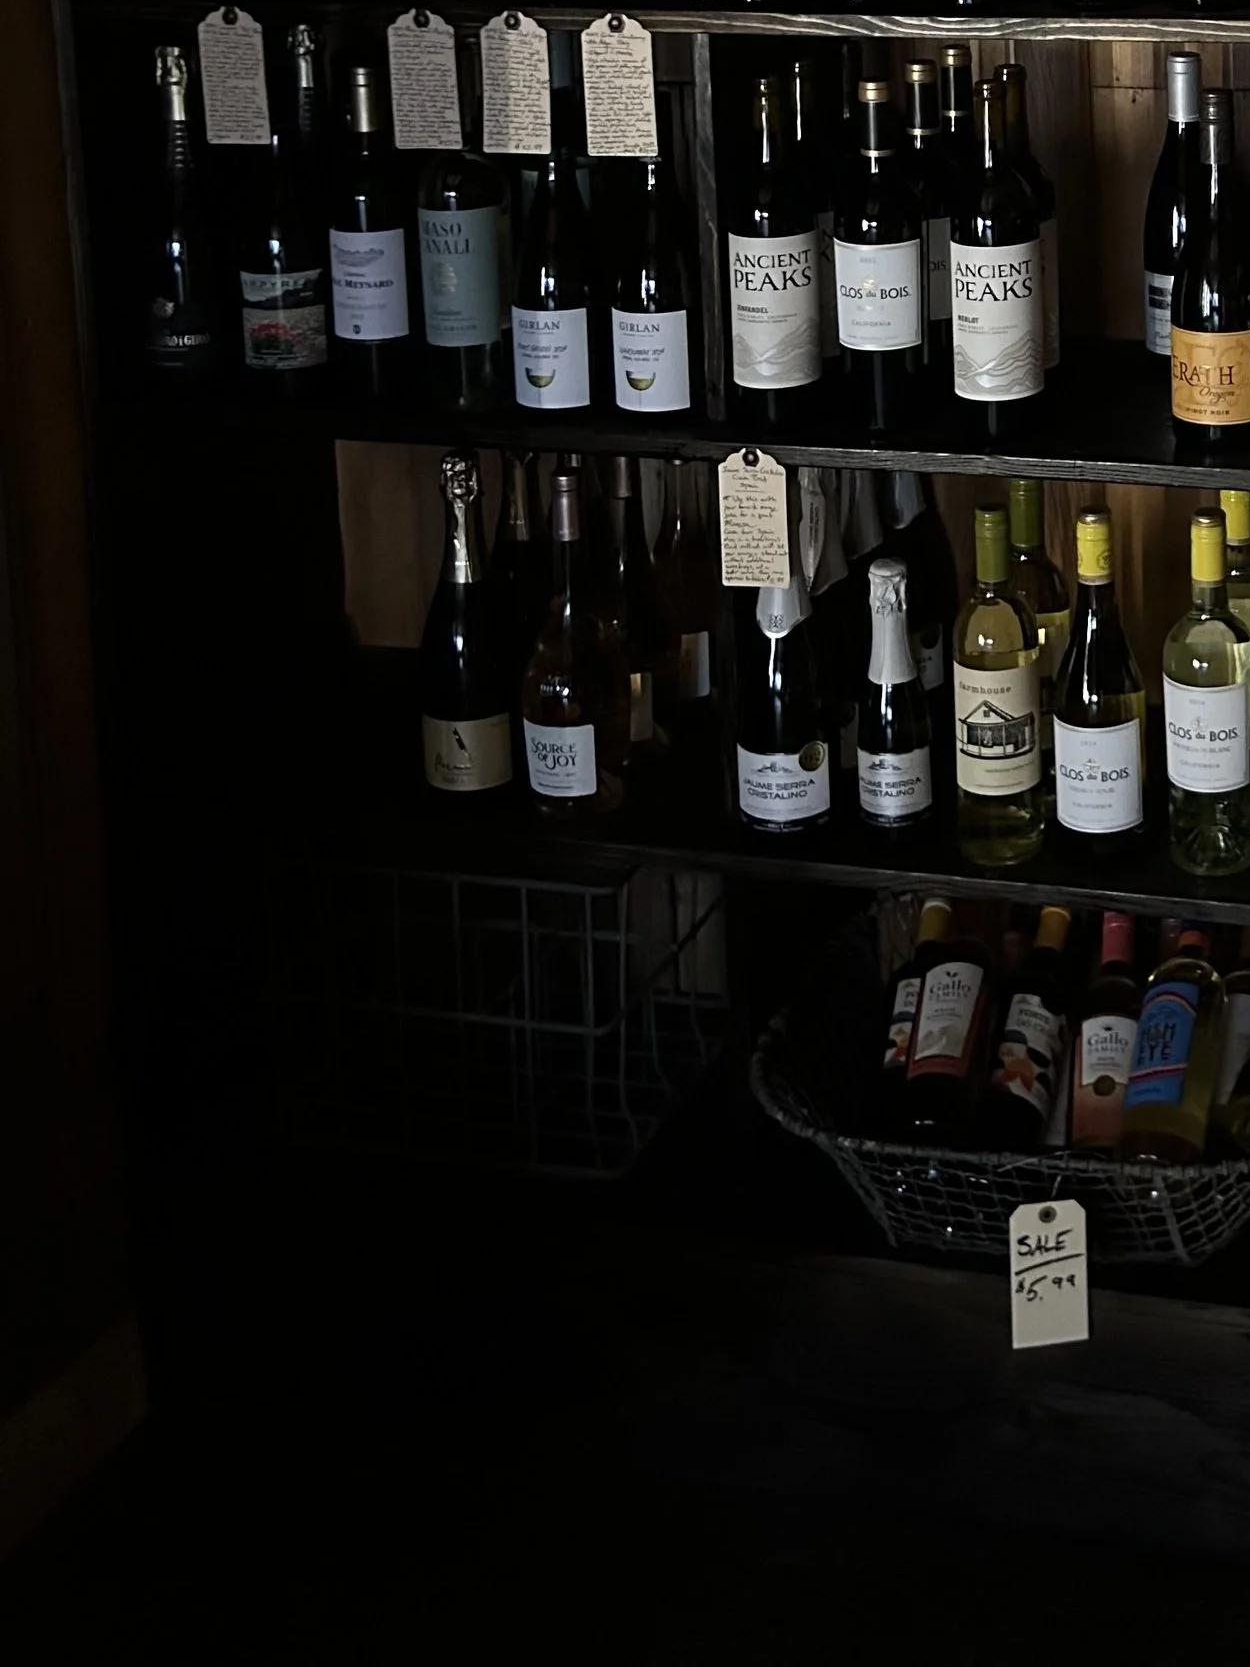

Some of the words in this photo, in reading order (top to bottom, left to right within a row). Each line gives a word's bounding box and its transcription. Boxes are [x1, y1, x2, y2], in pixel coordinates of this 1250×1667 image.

[734, 249, 812, 270] ANCIENT
[955, 260, 1032, 279] ANCIENT
[734, 266, 813, 292] PEAKS
[840, 285, 863, 299] CLOS
[880, 286, 909, 300] BOIS
[954, 277, 1033, 302] PEAKS
[518, 319, 560, 331] GIRLAN
[619, 321, 660, 333] GIRLAN
[1171, 355, 1235, 386] ERATH
[958, 684, 1012, 696] farmhouse
[1168, 722, 1192, 741] CLOS
[1209, 726, 1238, 742] BOIS
[530, 739, 577, 756] SOURCE
[545, 752, 578, 769] JOY
[1060, 766, 1084, 781] CLOS
[1101, 766, 1130, 781] BOIS
[775, 777, 816, 790] SERRA
[883, 776, 922, 790] SERRA
[748, 788, 808, 801] CRISTALINO
[929, 980, 973, 997] Gallo
[1087, 1033, 1129, 1048] Gallo
[1017, 1228, 1073, 1257] SALE
[1015, 1274, 1076, 1303] $5.99
